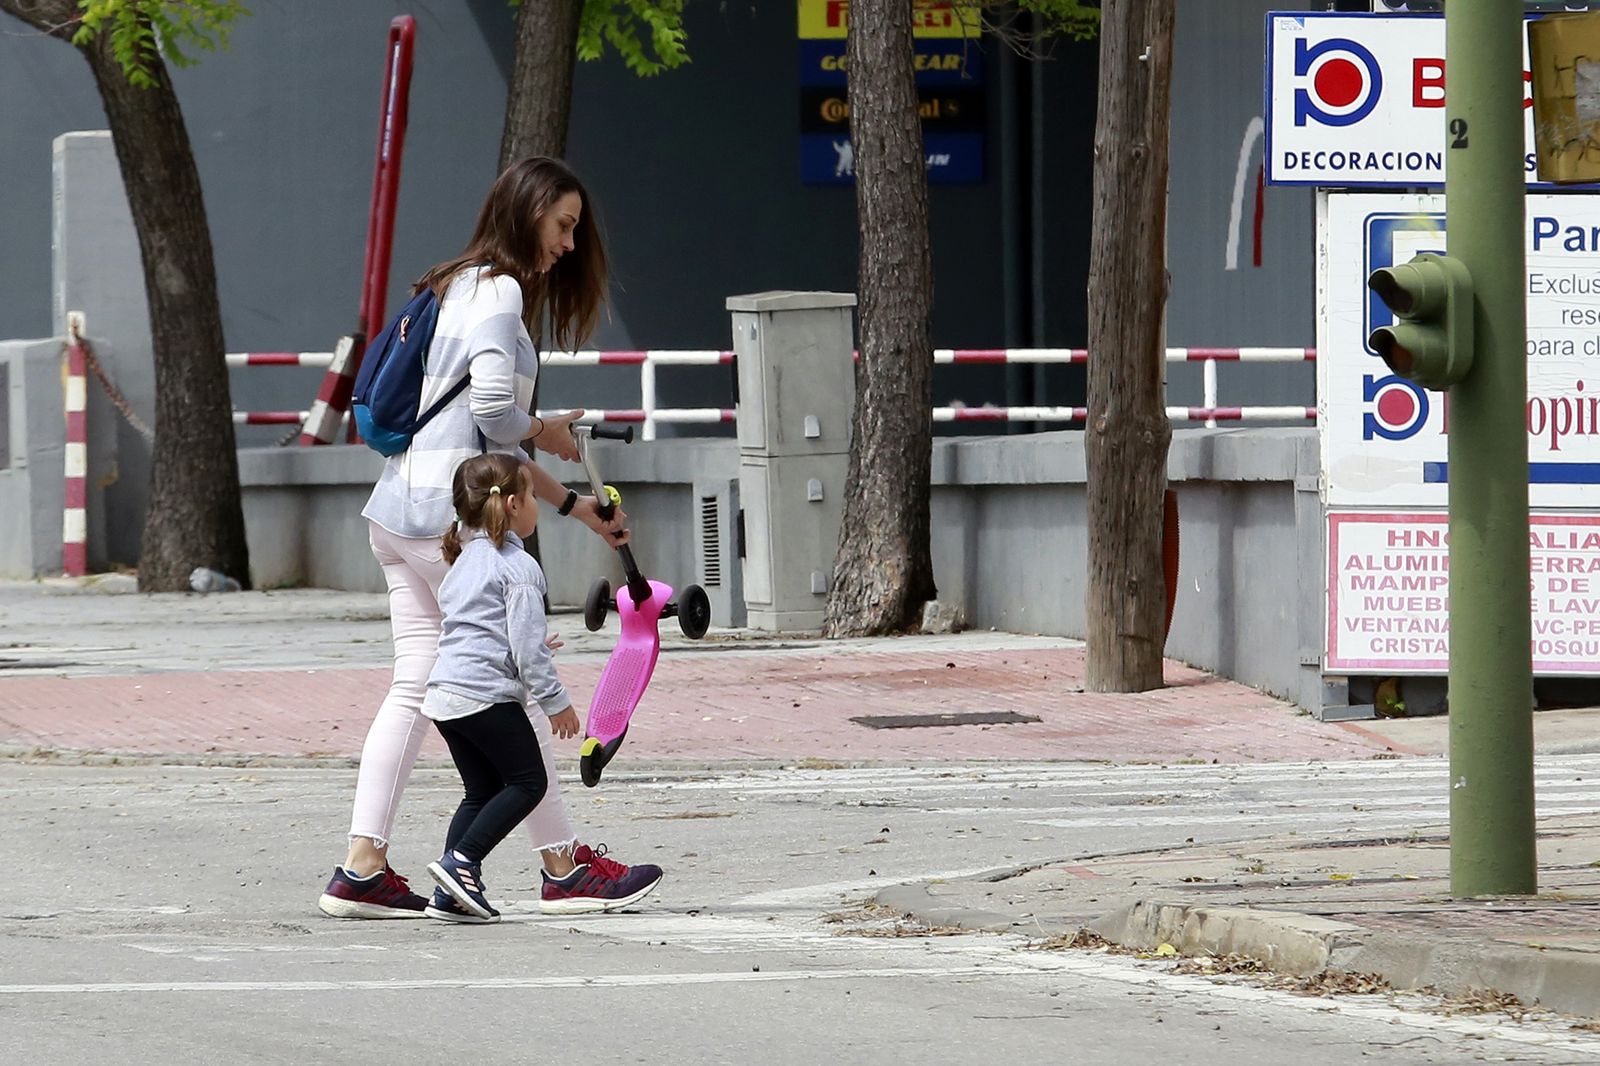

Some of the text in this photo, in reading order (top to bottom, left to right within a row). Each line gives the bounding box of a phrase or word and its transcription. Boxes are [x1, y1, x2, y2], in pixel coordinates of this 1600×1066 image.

[1450, 118, 1469, 149] 2
[1562, 309, 1600, 325] res
[1548, 577, 1590, 593] DE
[1363, 596, 1449, 612] MUEB
